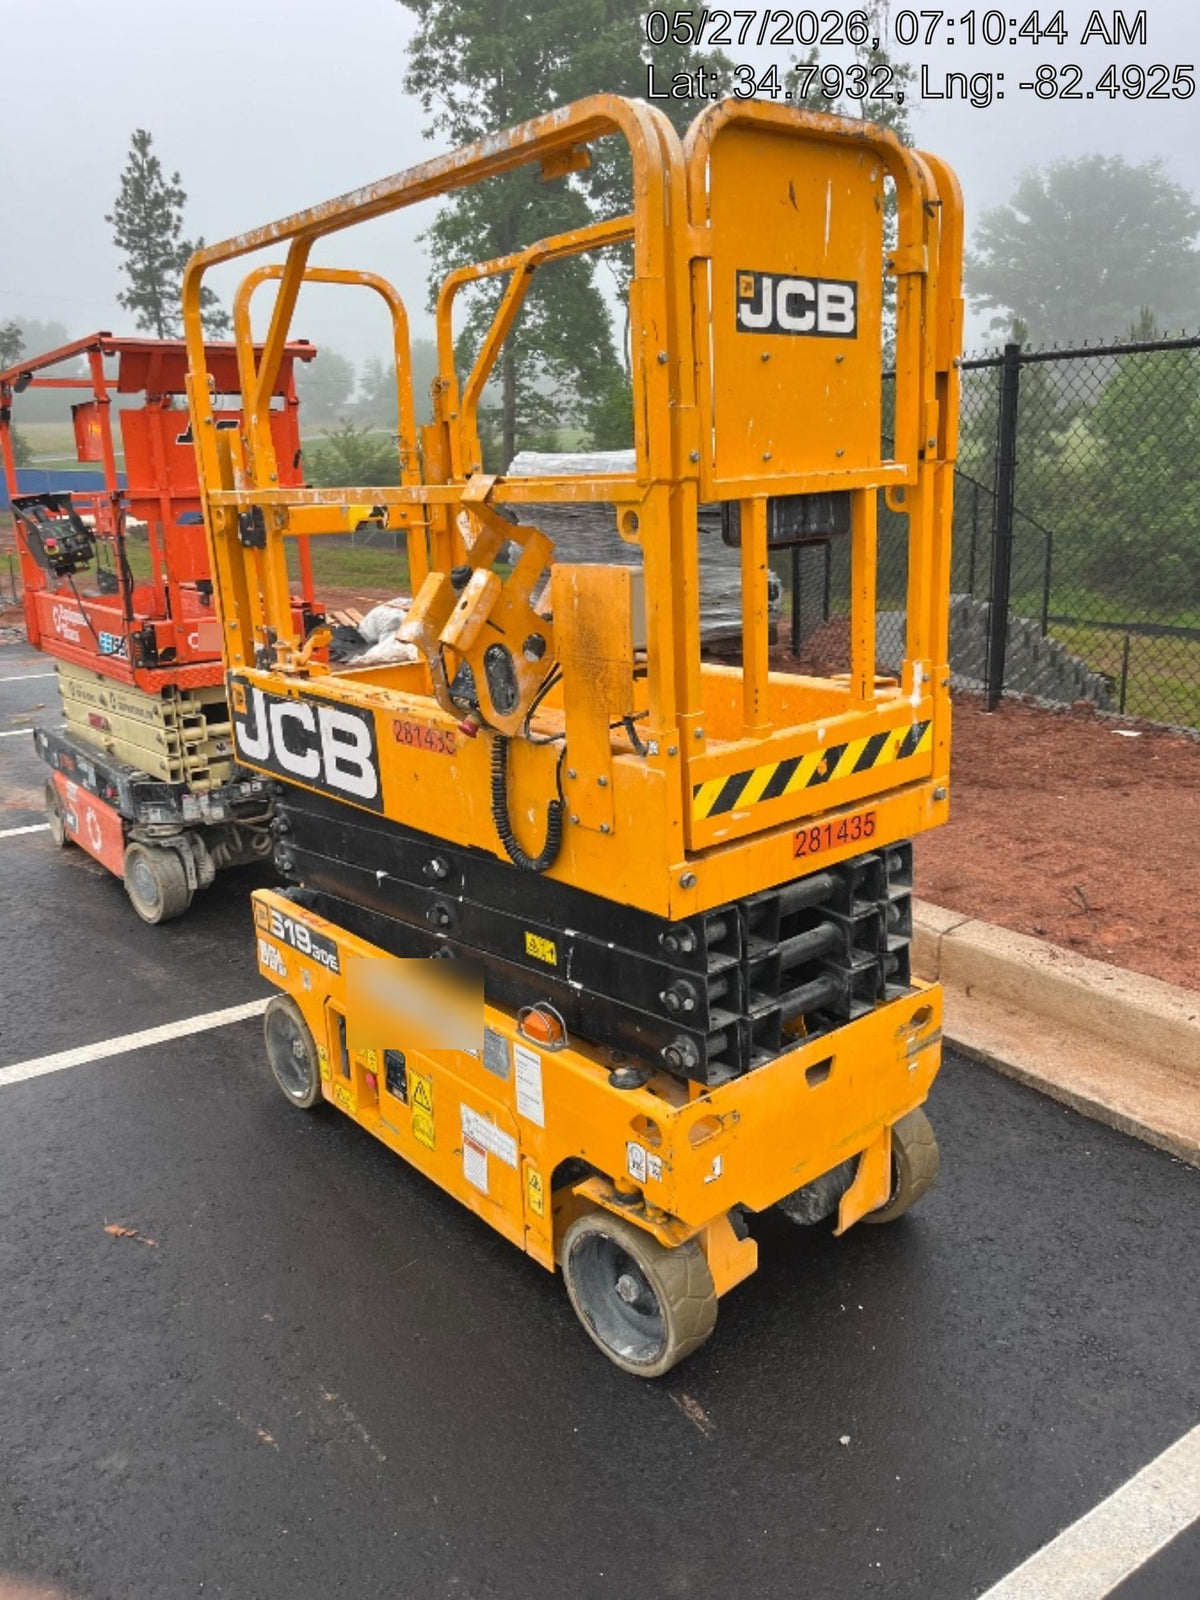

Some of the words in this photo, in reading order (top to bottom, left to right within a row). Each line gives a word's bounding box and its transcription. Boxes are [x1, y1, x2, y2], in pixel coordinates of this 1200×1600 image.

[740, 277, 855, 333] JCB
[235, 687, 378, 799] JCB
[795, 811, 876, 857] 281435
